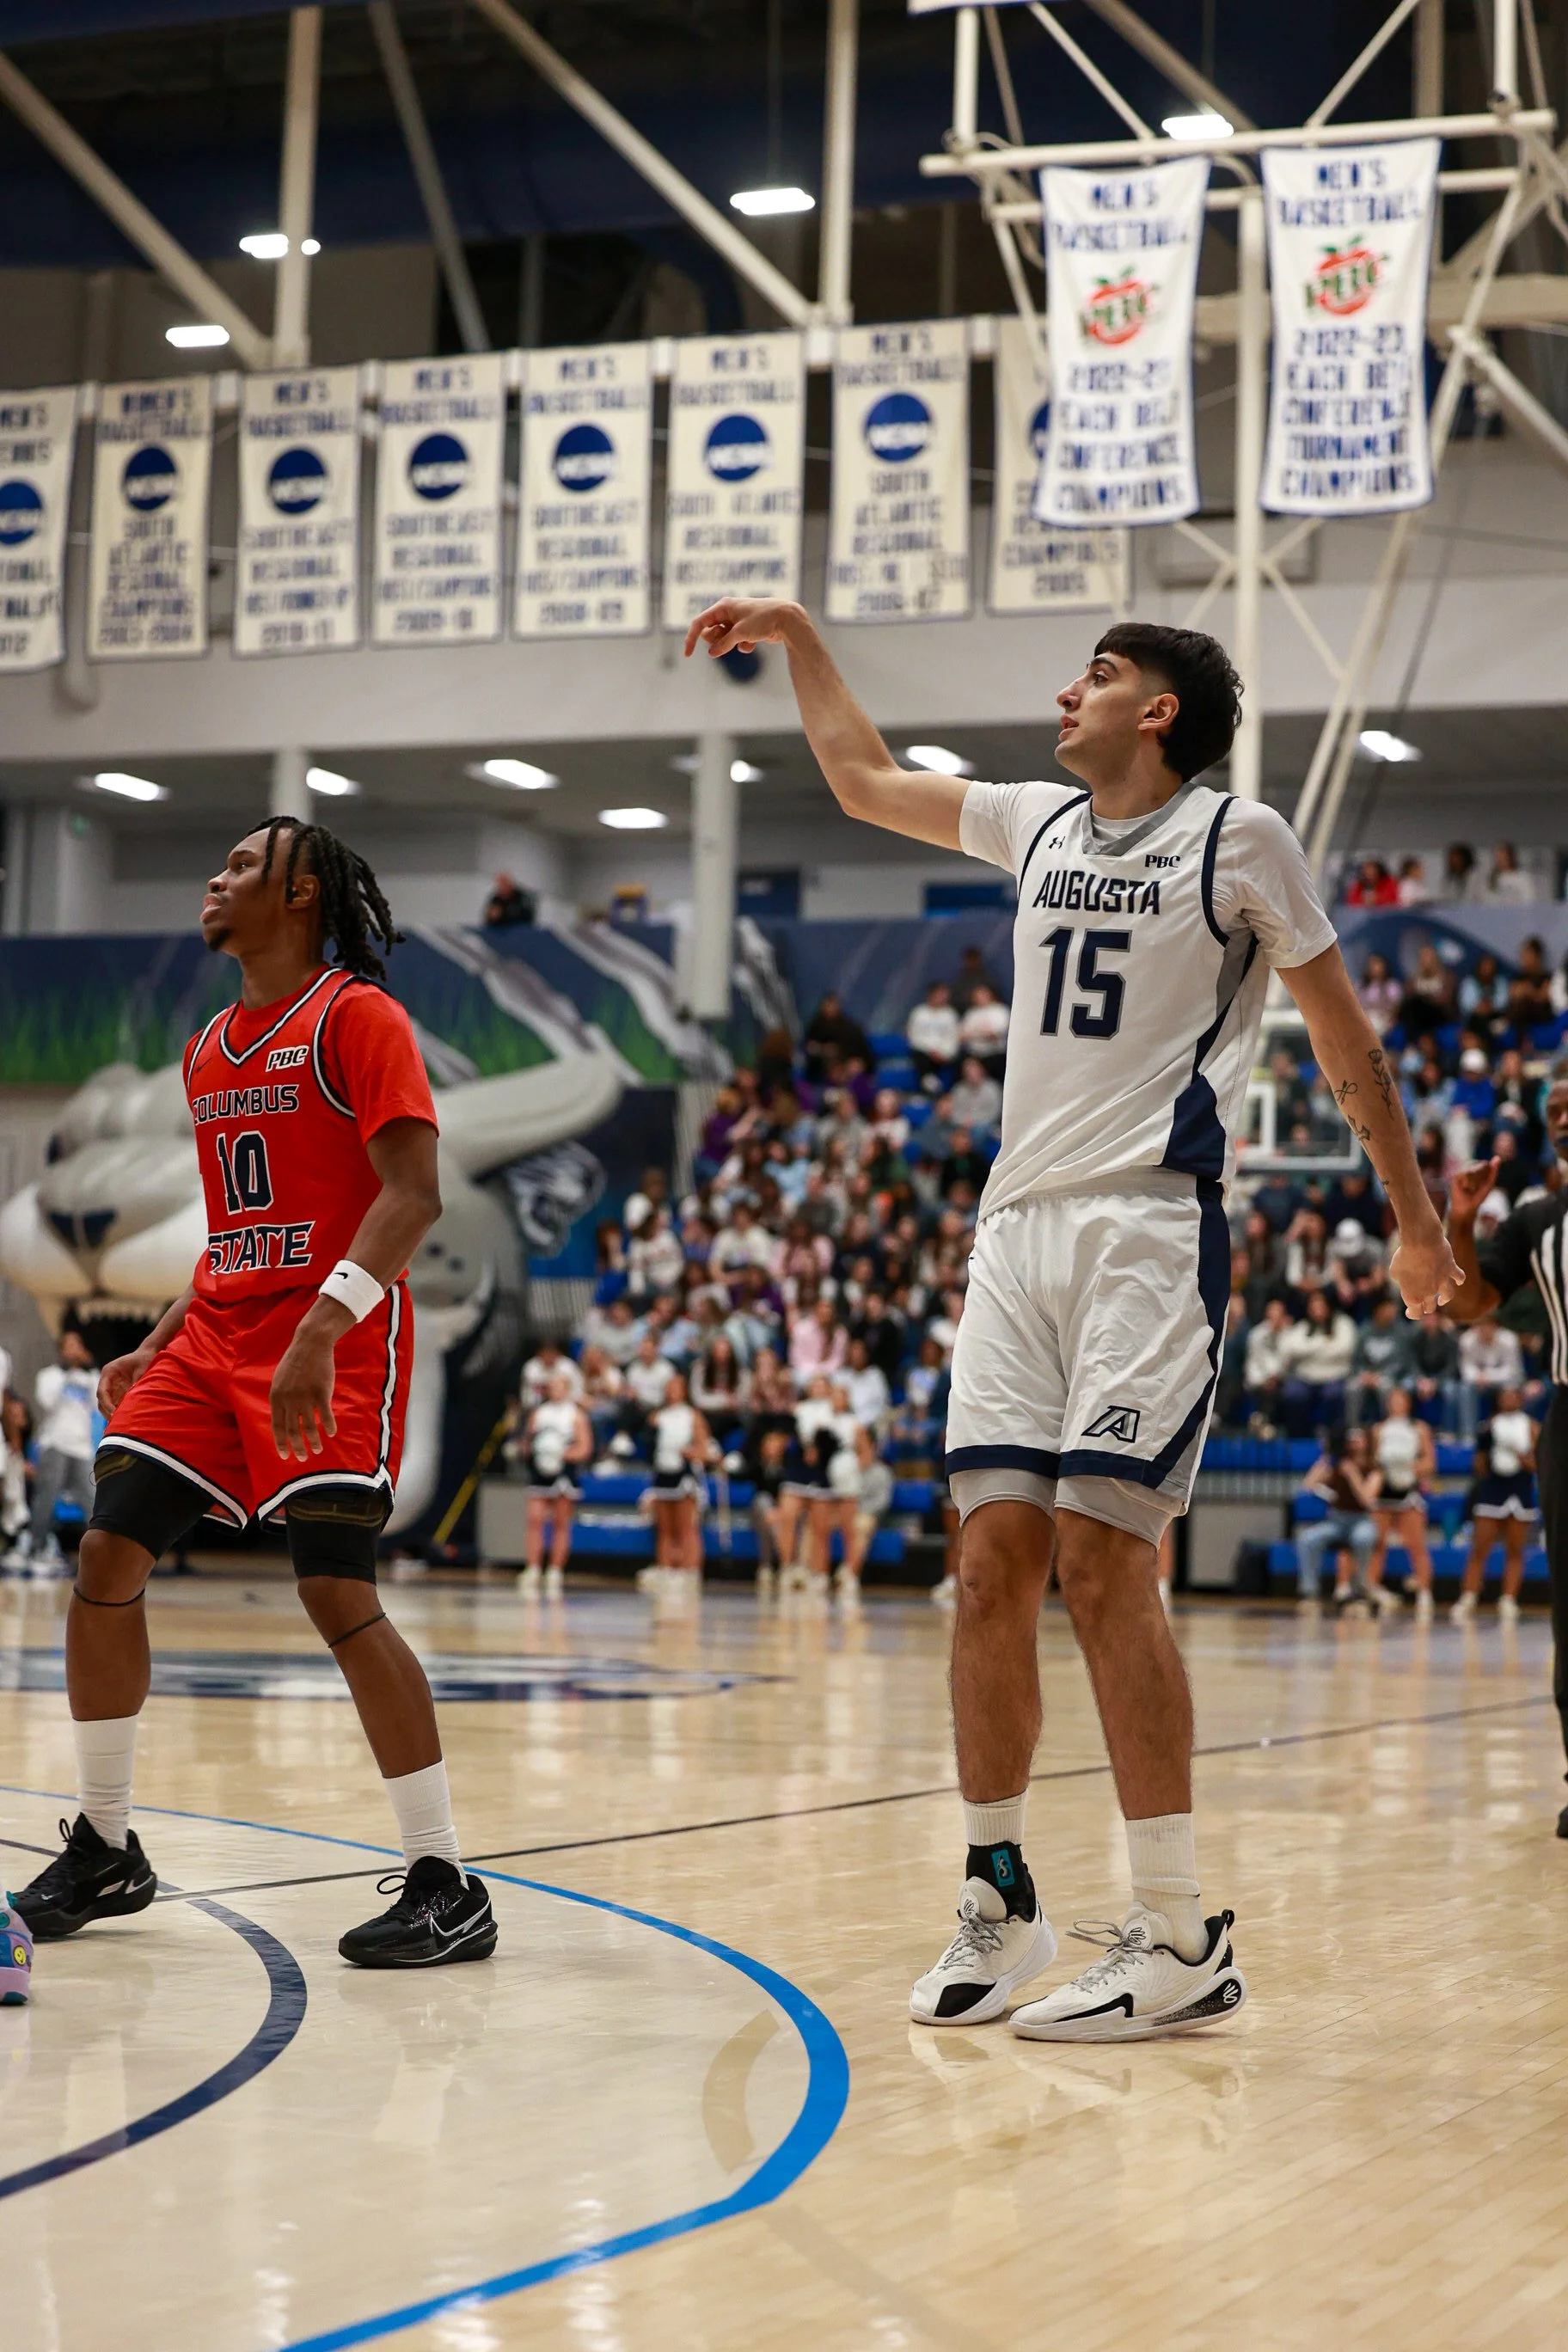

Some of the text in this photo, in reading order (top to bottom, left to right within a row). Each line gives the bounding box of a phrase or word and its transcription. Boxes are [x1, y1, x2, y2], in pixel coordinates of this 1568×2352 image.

[1318, 158, 1386, 190] MEN'S
[1092, 181, 1158, 209] MEN'S
[1279, 189, 1422, 225] BASKETBALL
[1055, 217, 1188, 249] BASKETBALL
[1057, 477, 1185, 511] CHAMPIONS
[1281, 464, 1415, 498] CHAMPIONS
[1144, 854, 1181, 868] PBC
[1032, 870, 1161, 916] AUGUSTA
[1039, 926, 1132, 1039] 15
[266, 1044, 309, 1073] PBC
[193, 1084, 299, 1125] COLUMBUS
[216, 1130, 273, 1216] 10
[208, 1221, 315, 1275] STATE
[1081, 1406, 1140, 1443] A
